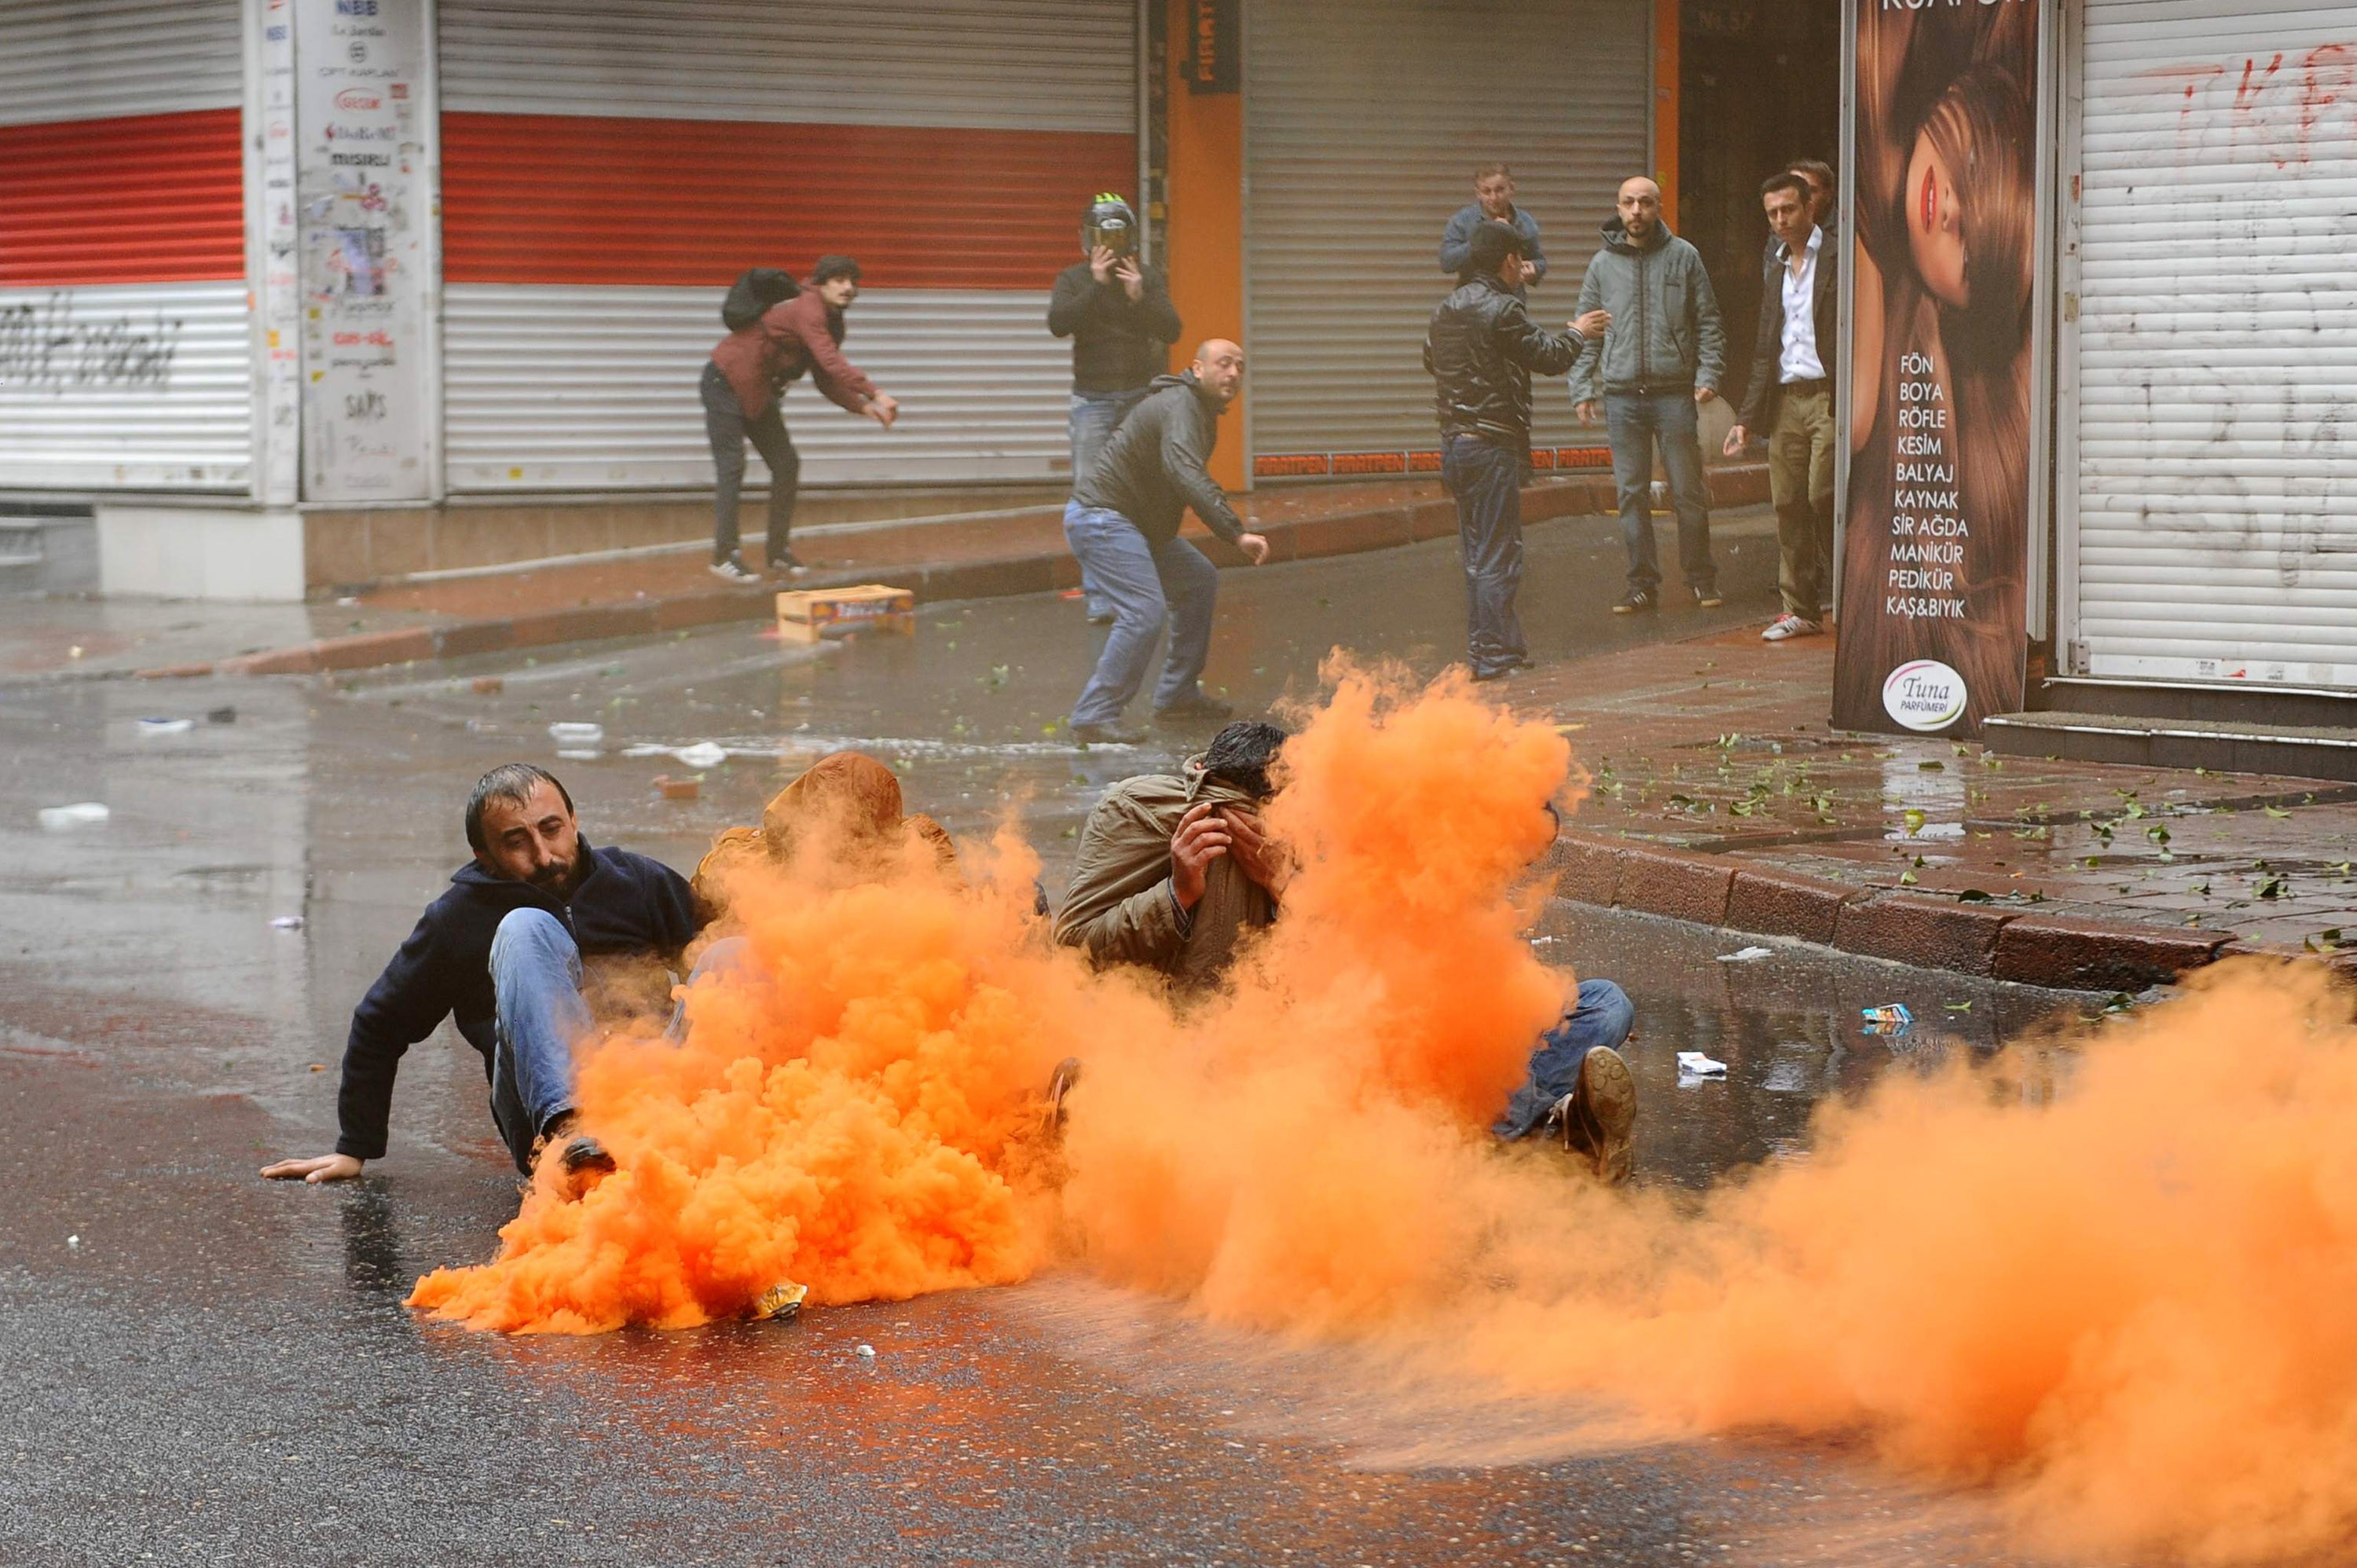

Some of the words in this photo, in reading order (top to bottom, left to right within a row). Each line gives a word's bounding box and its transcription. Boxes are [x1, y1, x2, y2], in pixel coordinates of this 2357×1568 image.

[1901, 352, 1934, 375] FÖN
[1899, 382, 1944, 402] BOYA
[1898, 405, 1946, 429] RÖFLE
[1897, 433, 1941, 456] KESİM
[1896, 462, 1954, 482] BALYAJ
[1894, 489, 1959, 510] KAYNAK
[1892, 512, 1915, 536] SİR
[1918, 514, 1969, 537] AĞDA
[1890, 540, 1964, 564] MANİKÜR
[1889, 567, 1953, 591] PEDİKÜR
[1886, 595, 1965, 619] KAŞ&BIYIK
[1903, 676, 1950, 699] Tuna
[1900, 700, 1948, 713] PARFÜMERİ
